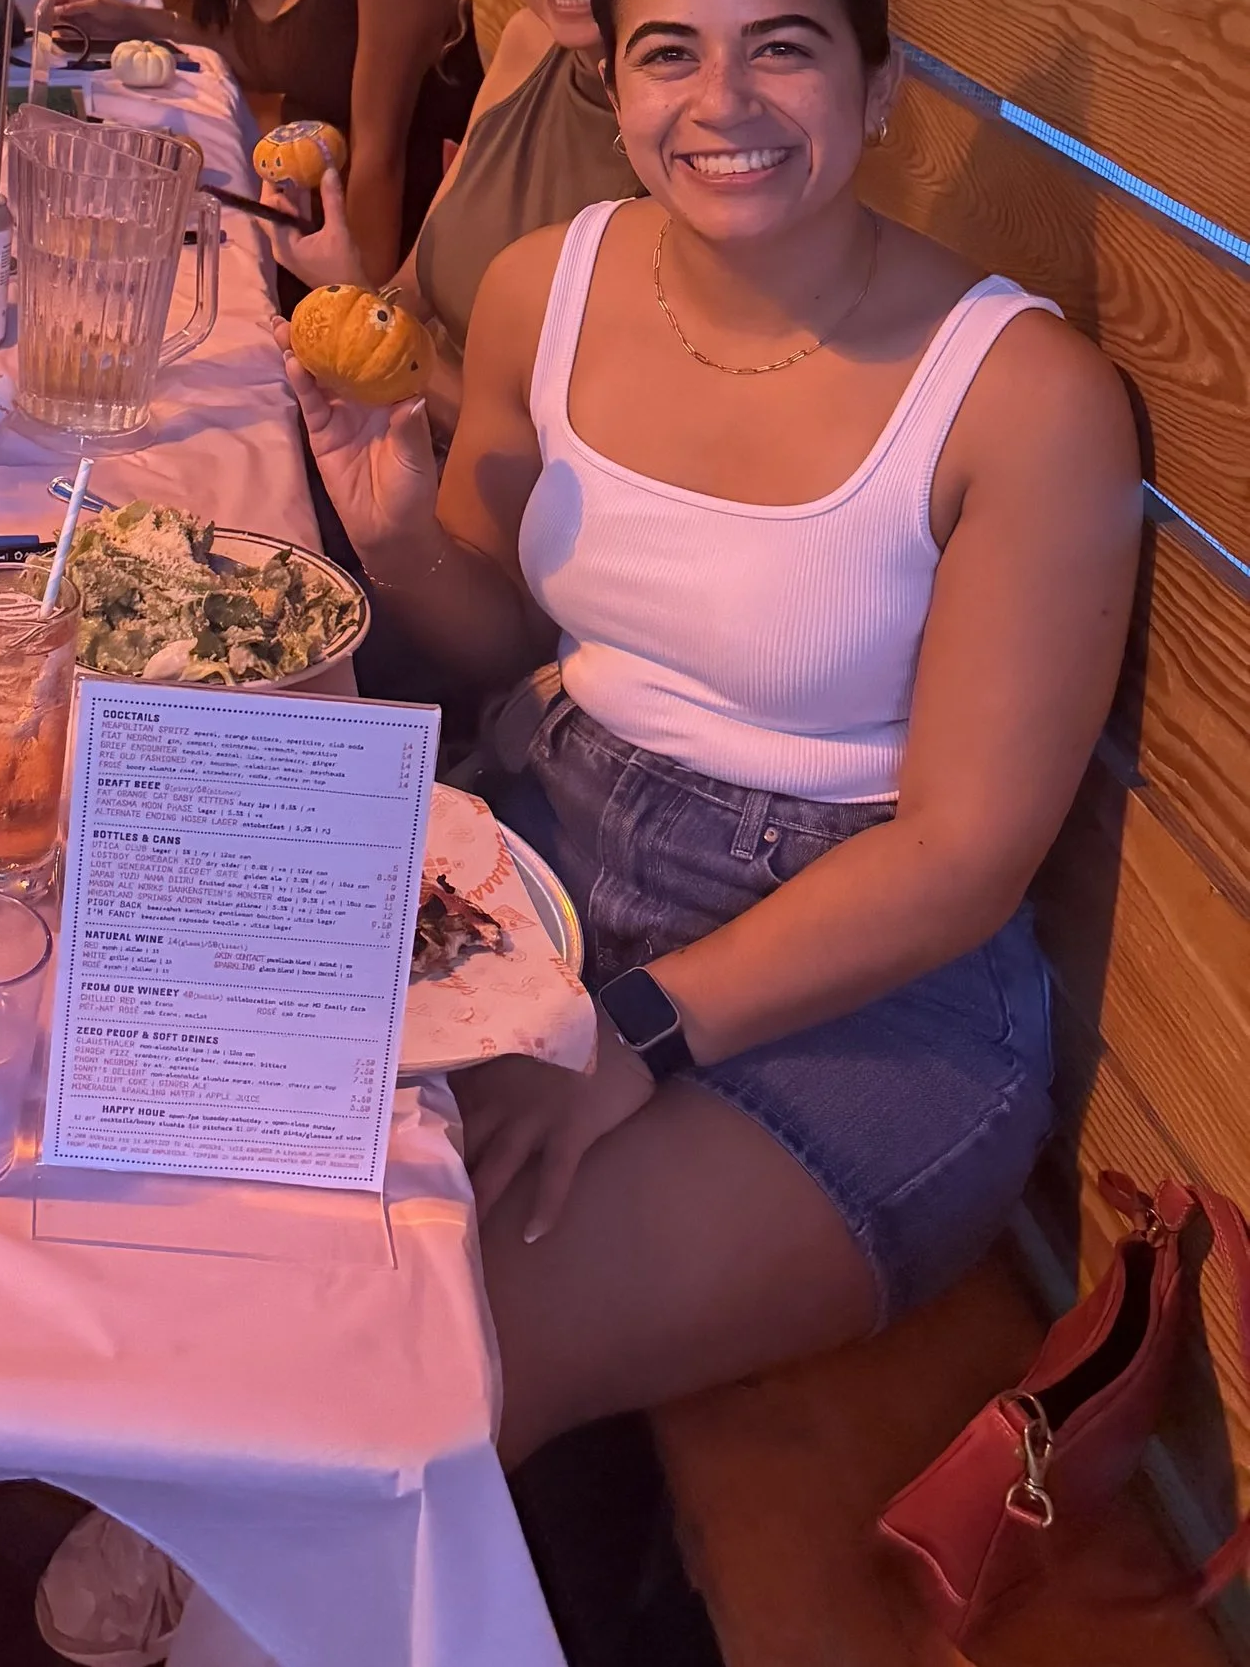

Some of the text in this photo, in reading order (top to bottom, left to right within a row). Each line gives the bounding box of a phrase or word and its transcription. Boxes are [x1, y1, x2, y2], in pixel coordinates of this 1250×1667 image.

[102, 709, 160, 722] COCKTAILS
[100, 720, 154, 735] NEAPOLITAN
[157, 725, 189, 735] SPRITZ
[100, 730, 162, 743] FIAT NEGRONI
[99, 740, 126, 750] BRIEF
[130, 742, 177, 754] ENCOUNTER
[98, 750, 187, 764] RYE OLD FASHIONED
[96, 777, 131, 788] DRAFT
[133, 779, 161, 790] BEER
[96, 788, 112, 796] FAT
[115, 788, 148, 799] ORANGE
[152, 791, 167, 800] CAT
[172, 793, 193, 802] BABY
[197, 795, 234, 805] KITTENS
[95, 797, 137, 808] FANTASMA
[140, 800, 163, 809] MOON
[165, 802, 193, 812] PHASE
[94, 806, 141, 818] ALTERNATE
[144, 811, 177, 821] ENDING
[210, 817, 238, 826] LAGER
[92, 829, 181, 845] BOTTLES & CANS
[91, 840, 120, 850] UTICA
[124, 843, 147, 852] CLUB
[90, 850, 129, 860] LOSTBOY
[134, 853, 179, 864] COMEBACK
[89, 860, 112, 868] LOST
[117, 861, 173, 873] GENERATION
[177, 865, 211, 876] SECRET
[119, 871, 140, 880] YUZU
[88, 878, 115, 887] MASON
[117, 881, 134, 889] ALE
[137, 882, 163, 891] WORKS
[86, 888, 203, 904] WHEATLAND SPRINGS ADORN
[384, 893, 395, 901] 10
[86, 897, 114, 907] PIGGY
[119, 900, 142, 909] BACK
[85, 907, 103, 916] I'M
[107, 909, 136, 918] FANCY
[84, 929, 164, 943] NATURAL WINE
[83, 940, 99, 949] RED
[81, 950, 107, 959] WHITE
[80, 981, 110, 991] FROM
[113, 984, 134, 993] OUR
[136, 985, 179, 997] WINERY
[80, 993, 136, 1004] CHILLED RED
[75, 1025, 219, 1044] ZERO PROOF & SOFT DRINKS
[103, 1057, 138, 1067] NEGRONI
[72, 1073, 92, 1081] COKE
[127, 1077, 147, 1086] COKE
[192, 1081, 207, 1089] ALE
[169, 1088, 195, 1098] WATER
[204, 1091, 231, 1100] APPLE
[101, 1104, 135, 1115] HAPPY
[137, 1107, 166, 1117] HOUR
